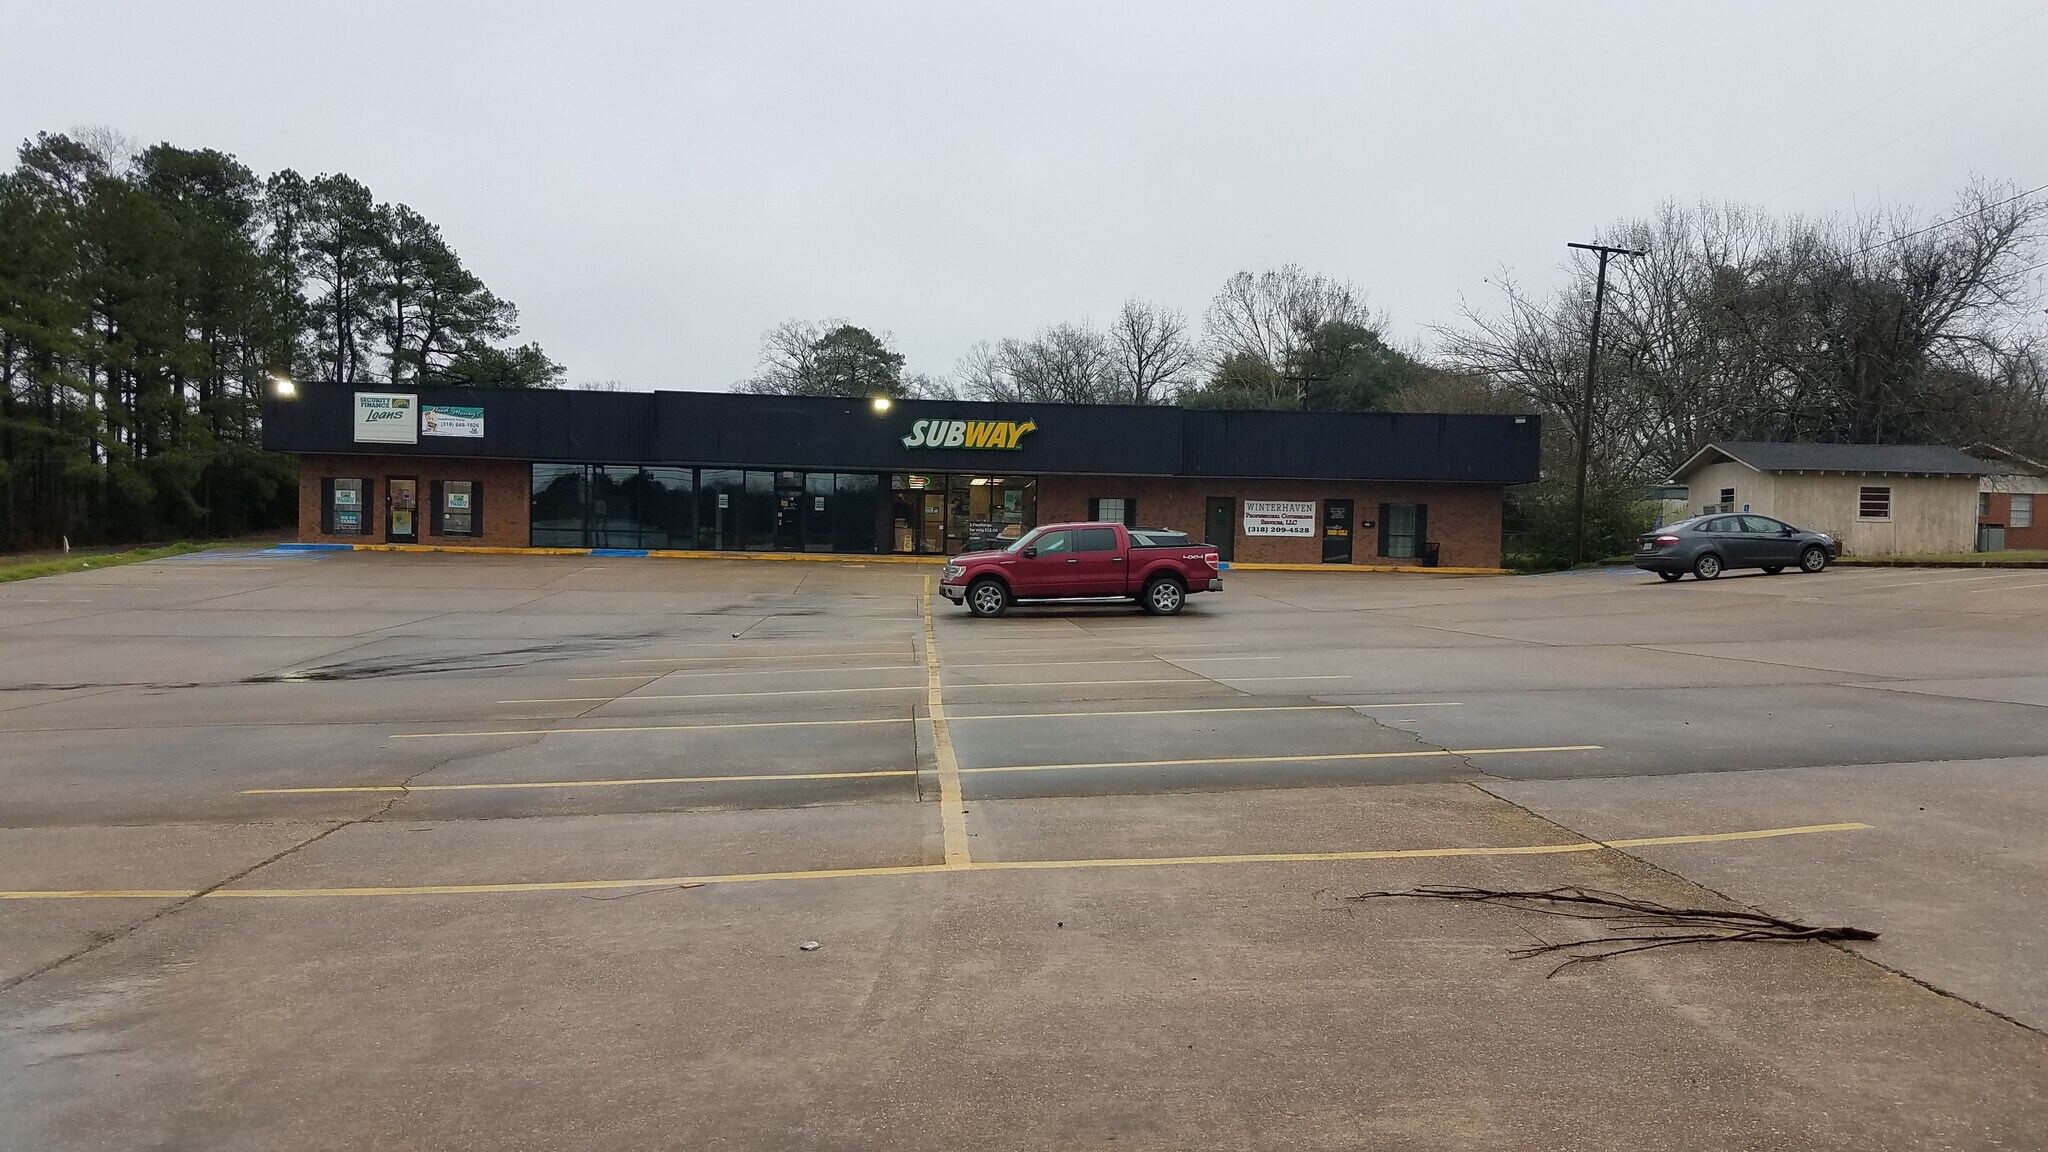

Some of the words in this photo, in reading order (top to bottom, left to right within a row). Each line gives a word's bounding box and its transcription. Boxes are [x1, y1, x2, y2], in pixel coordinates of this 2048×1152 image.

[365, 409, 404, 422] Loans
[451, 409, 483, 420] Money?
[901, 418, 1037, 449] SUBWAY
[1246, 502, 1313, 512] WINTERHAVEN
